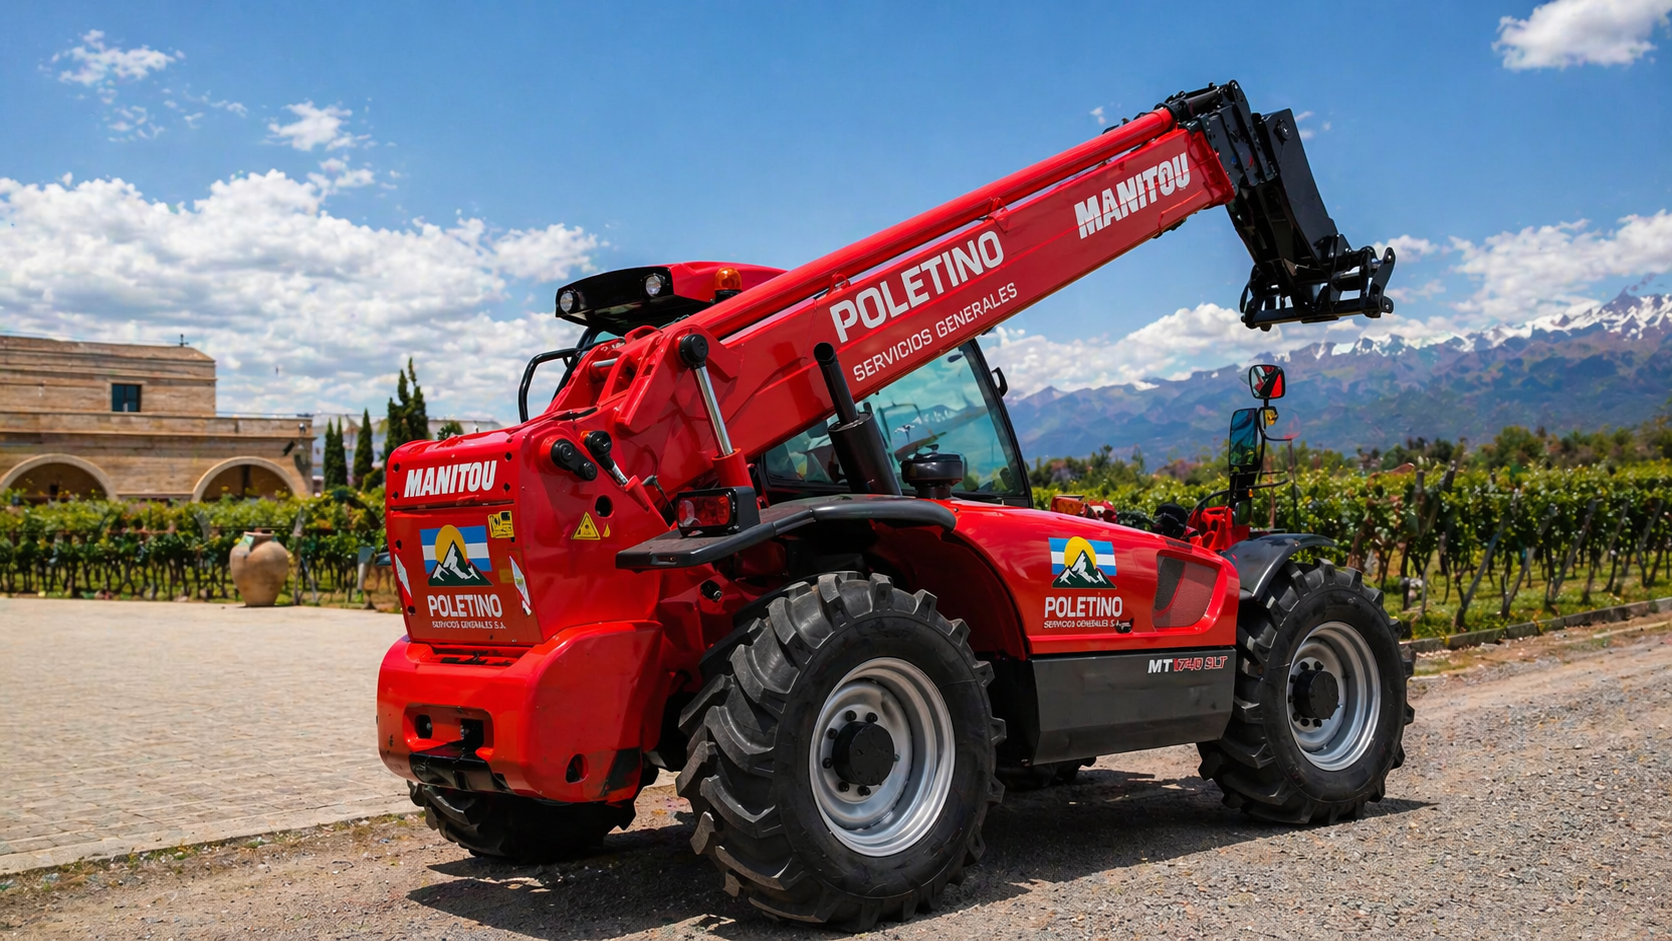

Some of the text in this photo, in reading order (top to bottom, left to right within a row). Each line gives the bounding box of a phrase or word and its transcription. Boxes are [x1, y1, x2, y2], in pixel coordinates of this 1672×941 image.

[1074, 152, 1191, 240] MANITOU
[829, 230, 1005, 343] POLETINO
[853, 282, 1018, 382] SERVICIOS GENERALES
[404, 460, 497, 498] MANITOU
[427, 594, 503, 618] POLETINO
[1044, 596, 1123, 618] POLETINO
